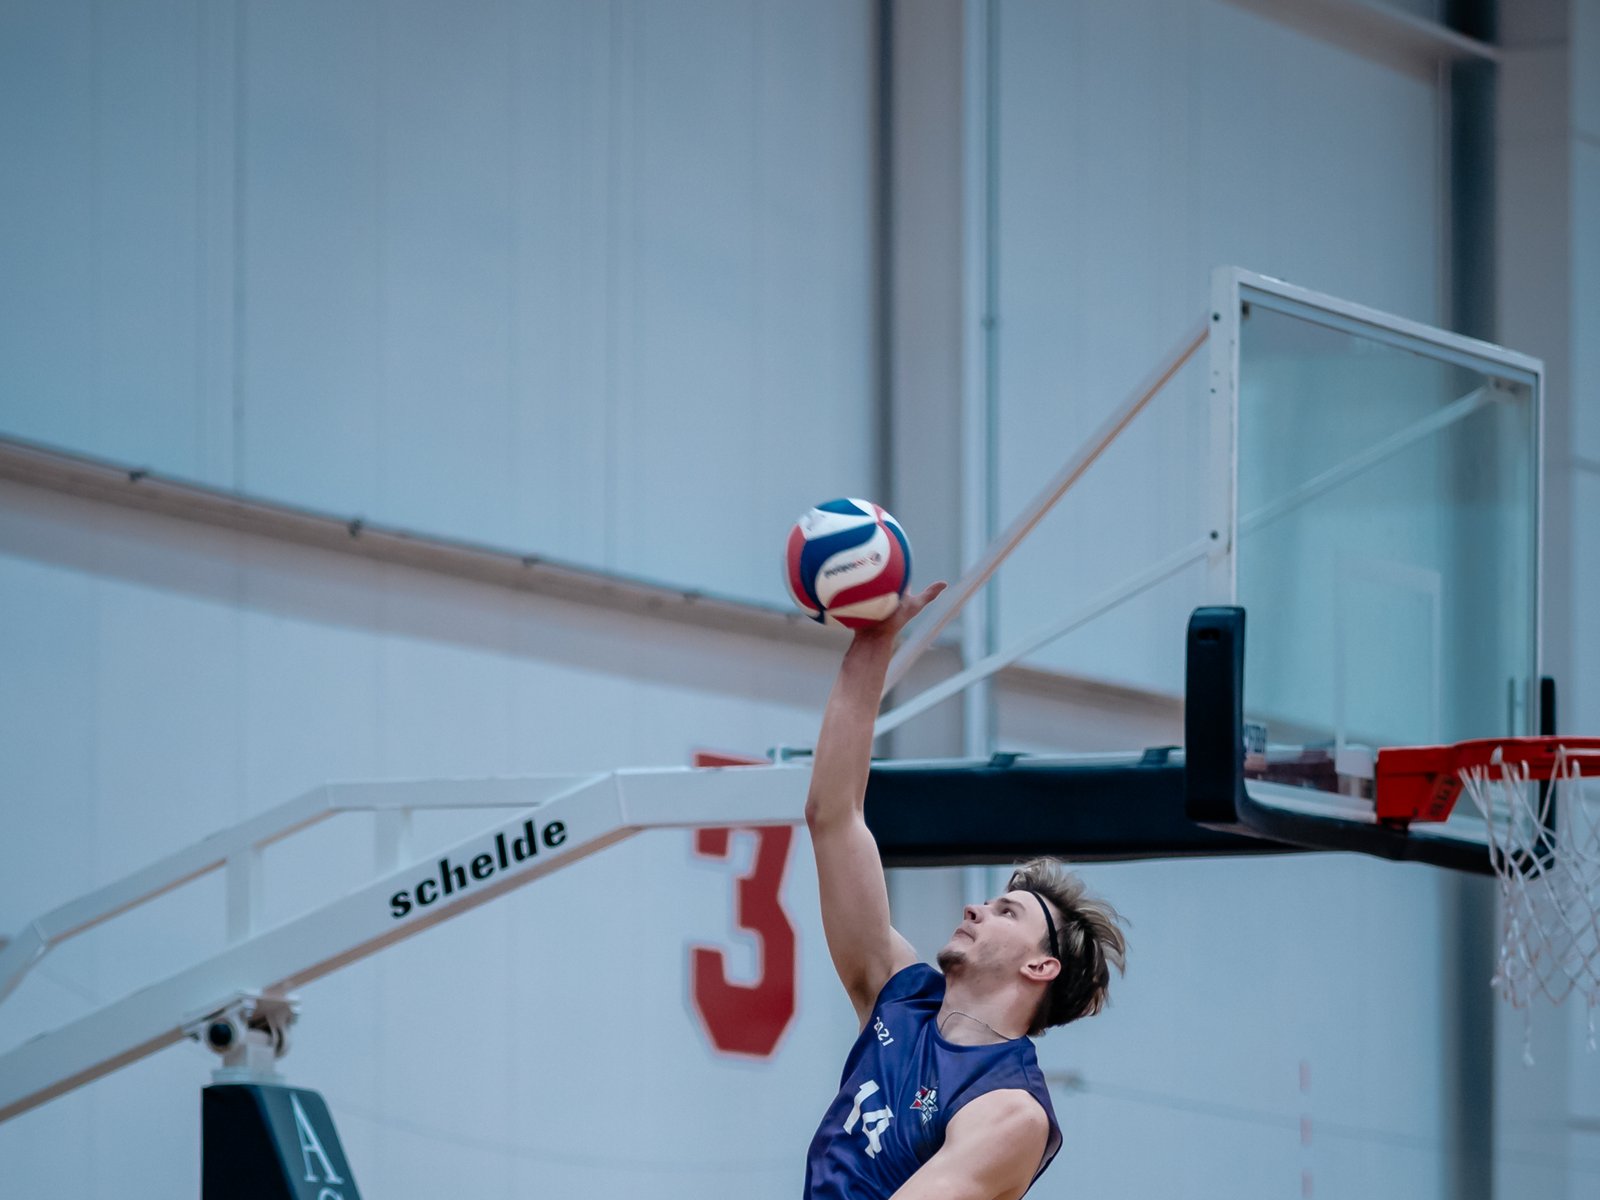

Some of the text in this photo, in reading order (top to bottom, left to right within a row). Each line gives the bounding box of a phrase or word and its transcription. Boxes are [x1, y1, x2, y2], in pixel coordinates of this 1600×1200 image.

[389, 818, 567, 919] schelde
[694, 752, 796, 1057] 3
[843, 1079, 894, 1159] 14
